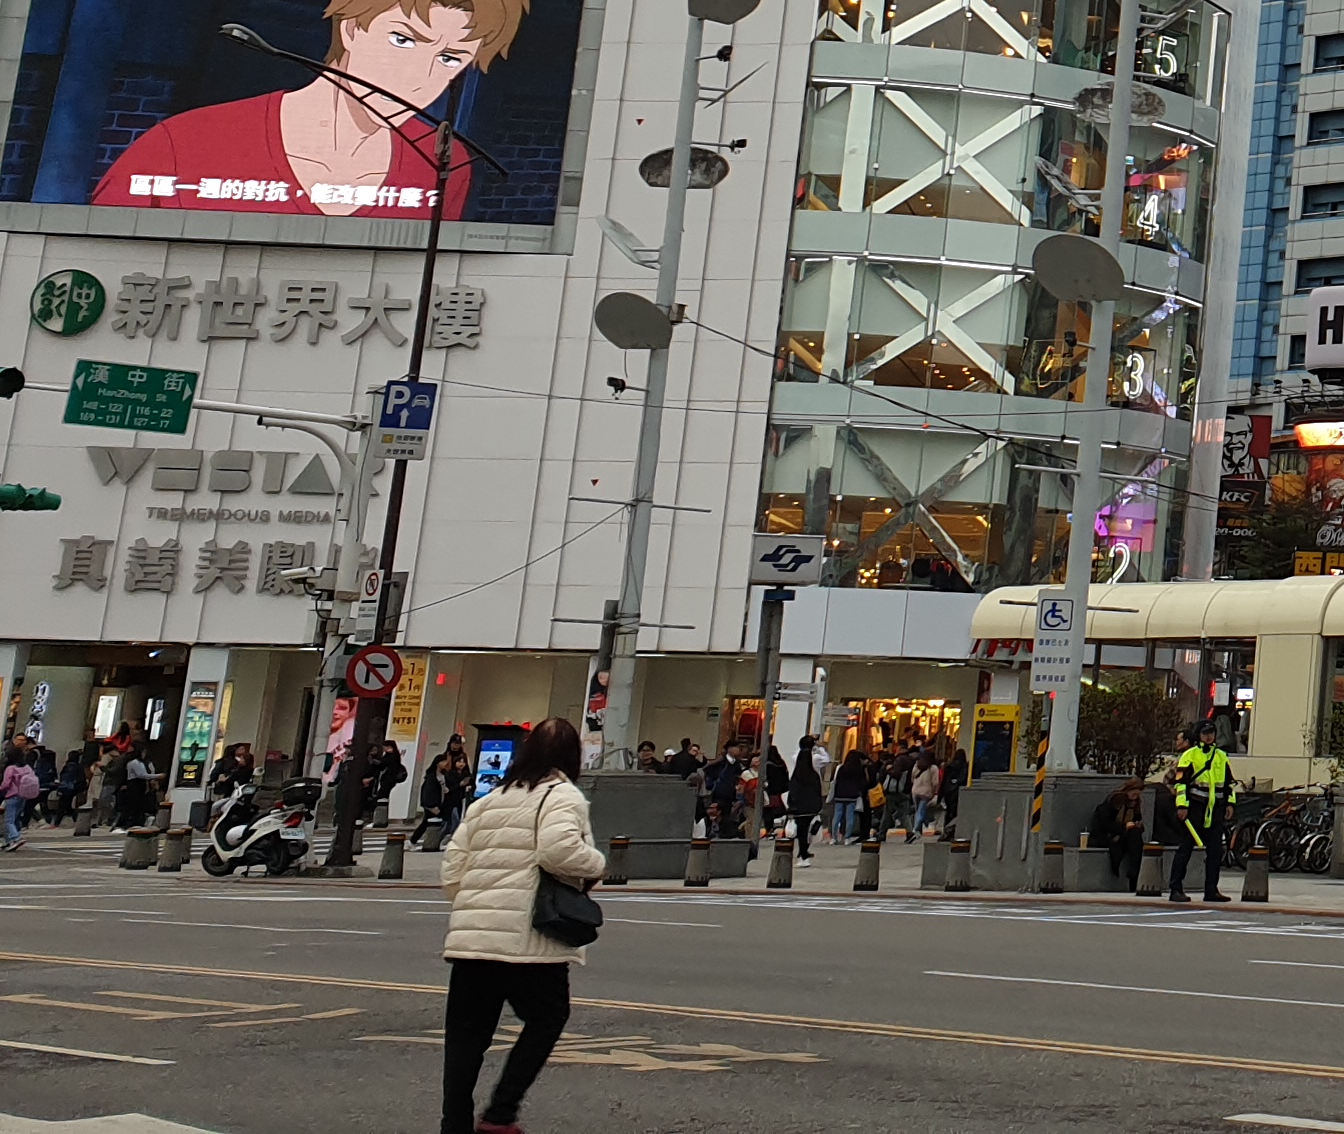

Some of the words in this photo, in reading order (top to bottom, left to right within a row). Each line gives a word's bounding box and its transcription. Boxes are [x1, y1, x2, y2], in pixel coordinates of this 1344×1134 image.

[1155, 37, 1178, 78] 5
[1139, 196, 1160, 242] 4
[112, 273, 487, 350] 新世界大樓
[87, 364, 186, 392] 漢中街
[1122, 350, 1144, 398] 3
[386, 385, 411, 414] P
[146, 506, 270, 524] TREMENDOUS
[278, 509, 332, 524] MEDIA
[1221, 490, 1250, 503] KFC
[53, 535, 380, 599] 真善美劇
[1106, 542, 1130, 584] 2
